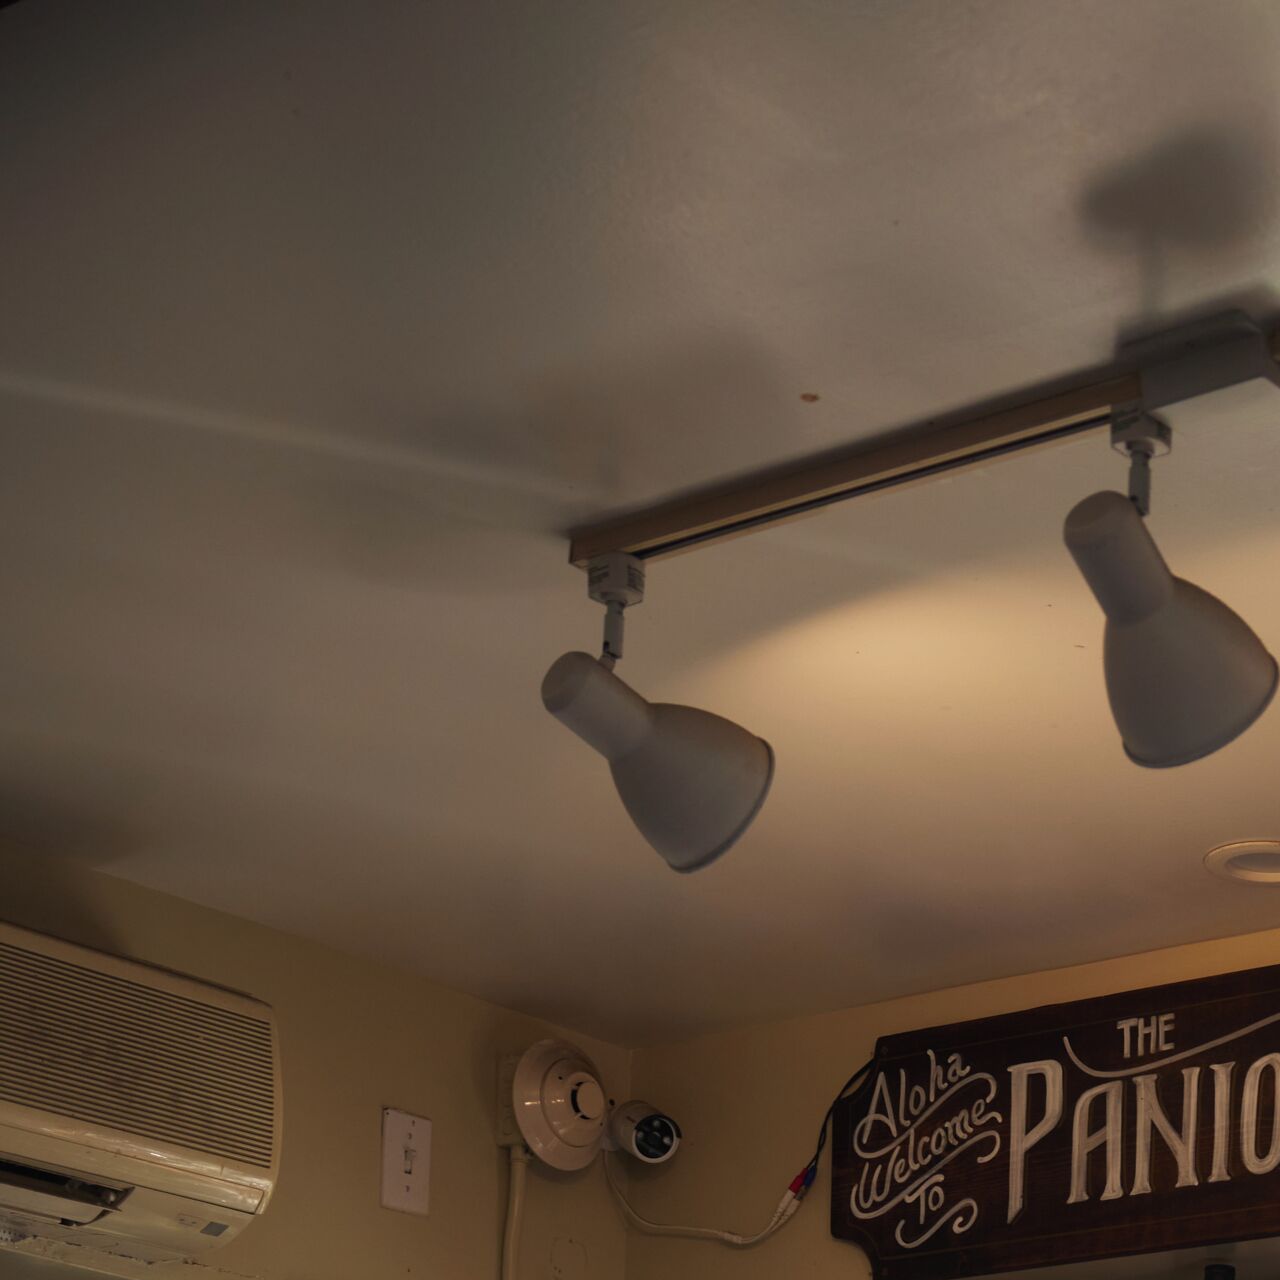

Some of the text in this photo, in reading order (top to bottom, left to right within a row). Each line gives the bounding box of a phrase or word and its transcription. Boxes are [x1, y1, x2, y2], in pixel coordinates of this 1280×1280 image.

[1116, 1012, 1175, 1060] THE
[858, 1049, 971, 1145] Aloha
[856, 1096, 1002, 1208] Welcome
[908, 1174, 946, 1226] To
